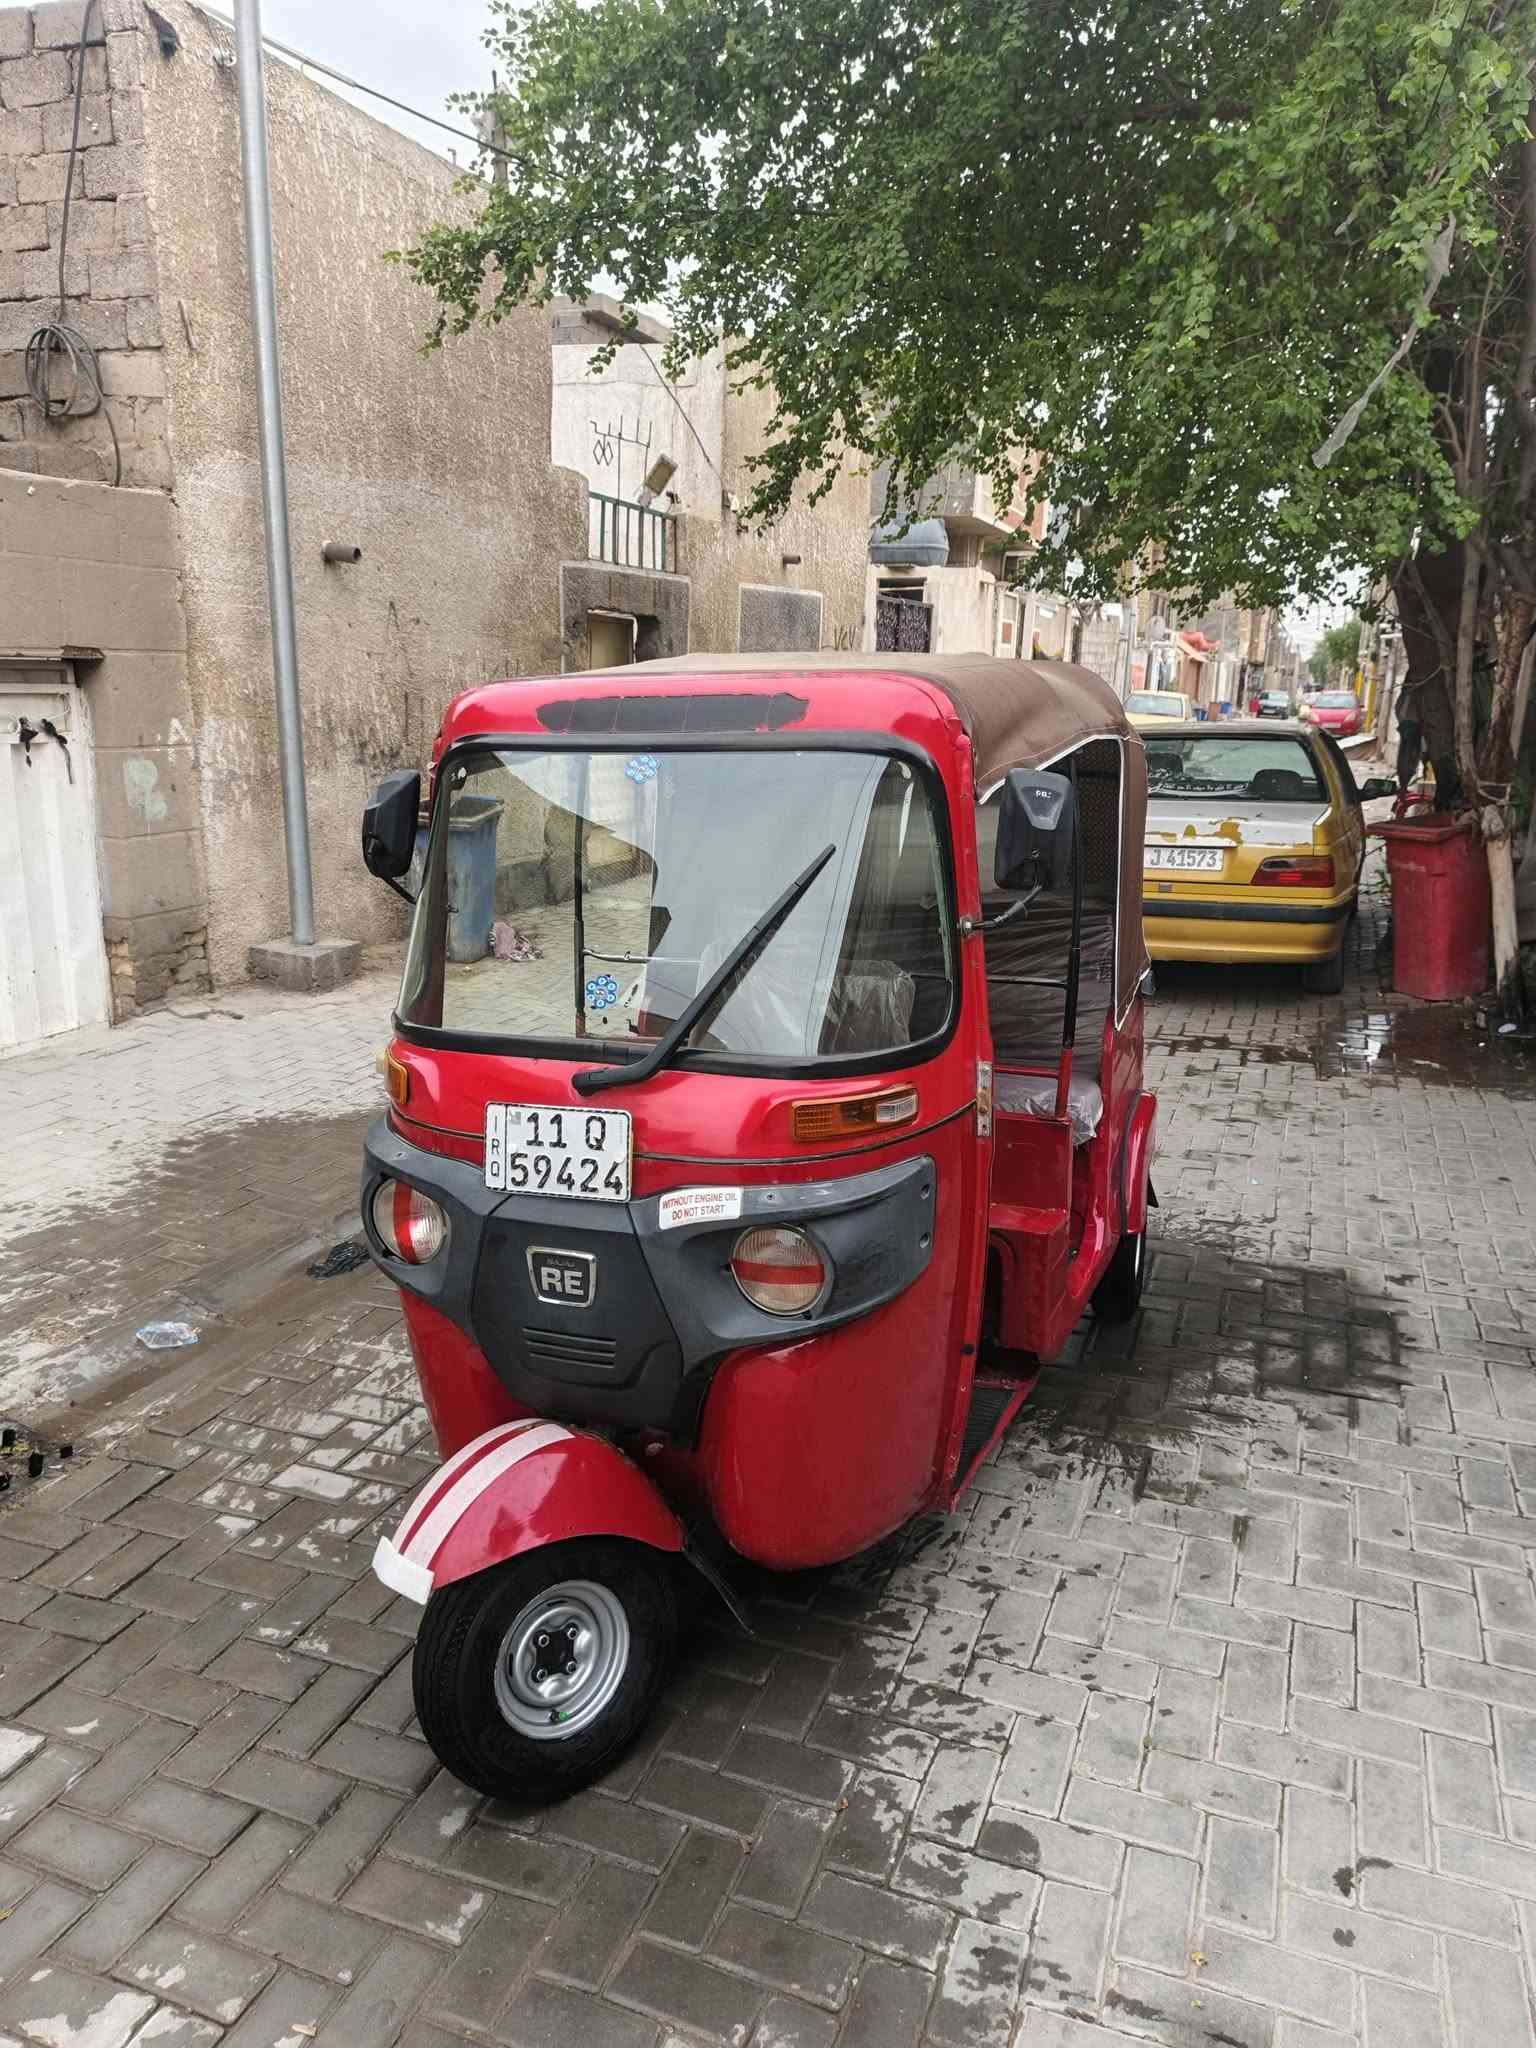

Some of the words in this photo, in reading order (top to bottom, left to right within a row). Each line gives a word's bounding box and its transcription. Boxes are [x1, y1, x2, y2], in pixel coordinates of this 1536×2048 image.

[1166, 848, 1218, 867] 41573
[526, 1111, 568, 1149] 11
[585, 1115, 605, 1151] Q
[490, 1115, 501, 1178] IRQ
[510, 1152, 624, 1195] 59424
[662, 1194, 694, 1209] WITHOUT
[695, 1192, 724, 1204] ENGINE
[725, 1192, 738, 1201] OIL
[672, 1208, 683, 1220] DO
[684, 1206, 699, 1217] NOT
[701, 1204, 726, 1216] START
[541, 1266, 584, 1295] RE
